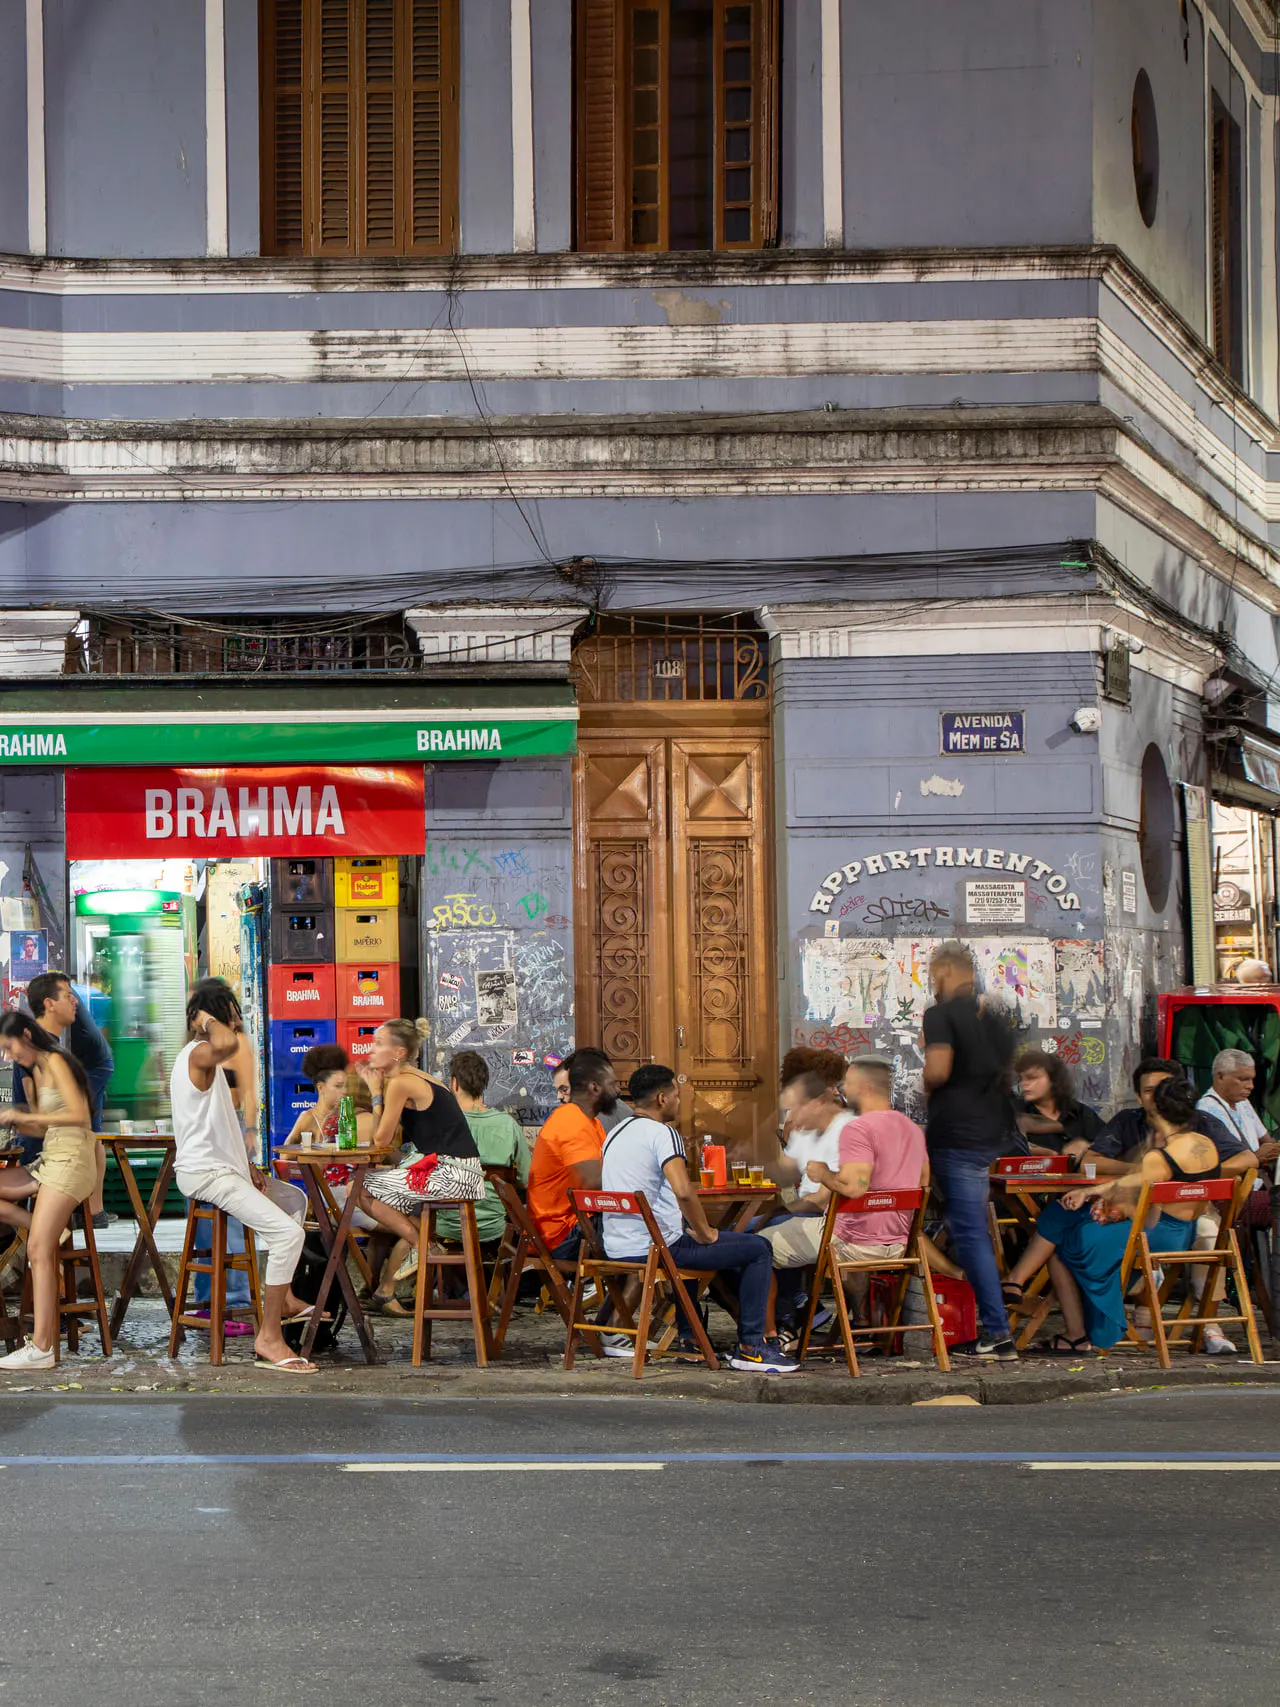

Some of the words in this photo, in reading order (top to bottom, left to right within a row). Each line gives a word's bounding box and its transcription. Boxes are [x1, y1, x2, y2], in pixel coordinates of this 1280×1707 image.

[655, 660, 681, 676] 108
[954, 716, 1012, 728] AVENIDA
[416, 729, 502, 751] BRAHMA
[145, 785, 346, 839] BRAHMA
[808, 846, 1081, 914] APPARTAMENTOS
[286, 990, 320, 1002] BRAHMA
[352, 996, 384, 1006] BRAHMA
